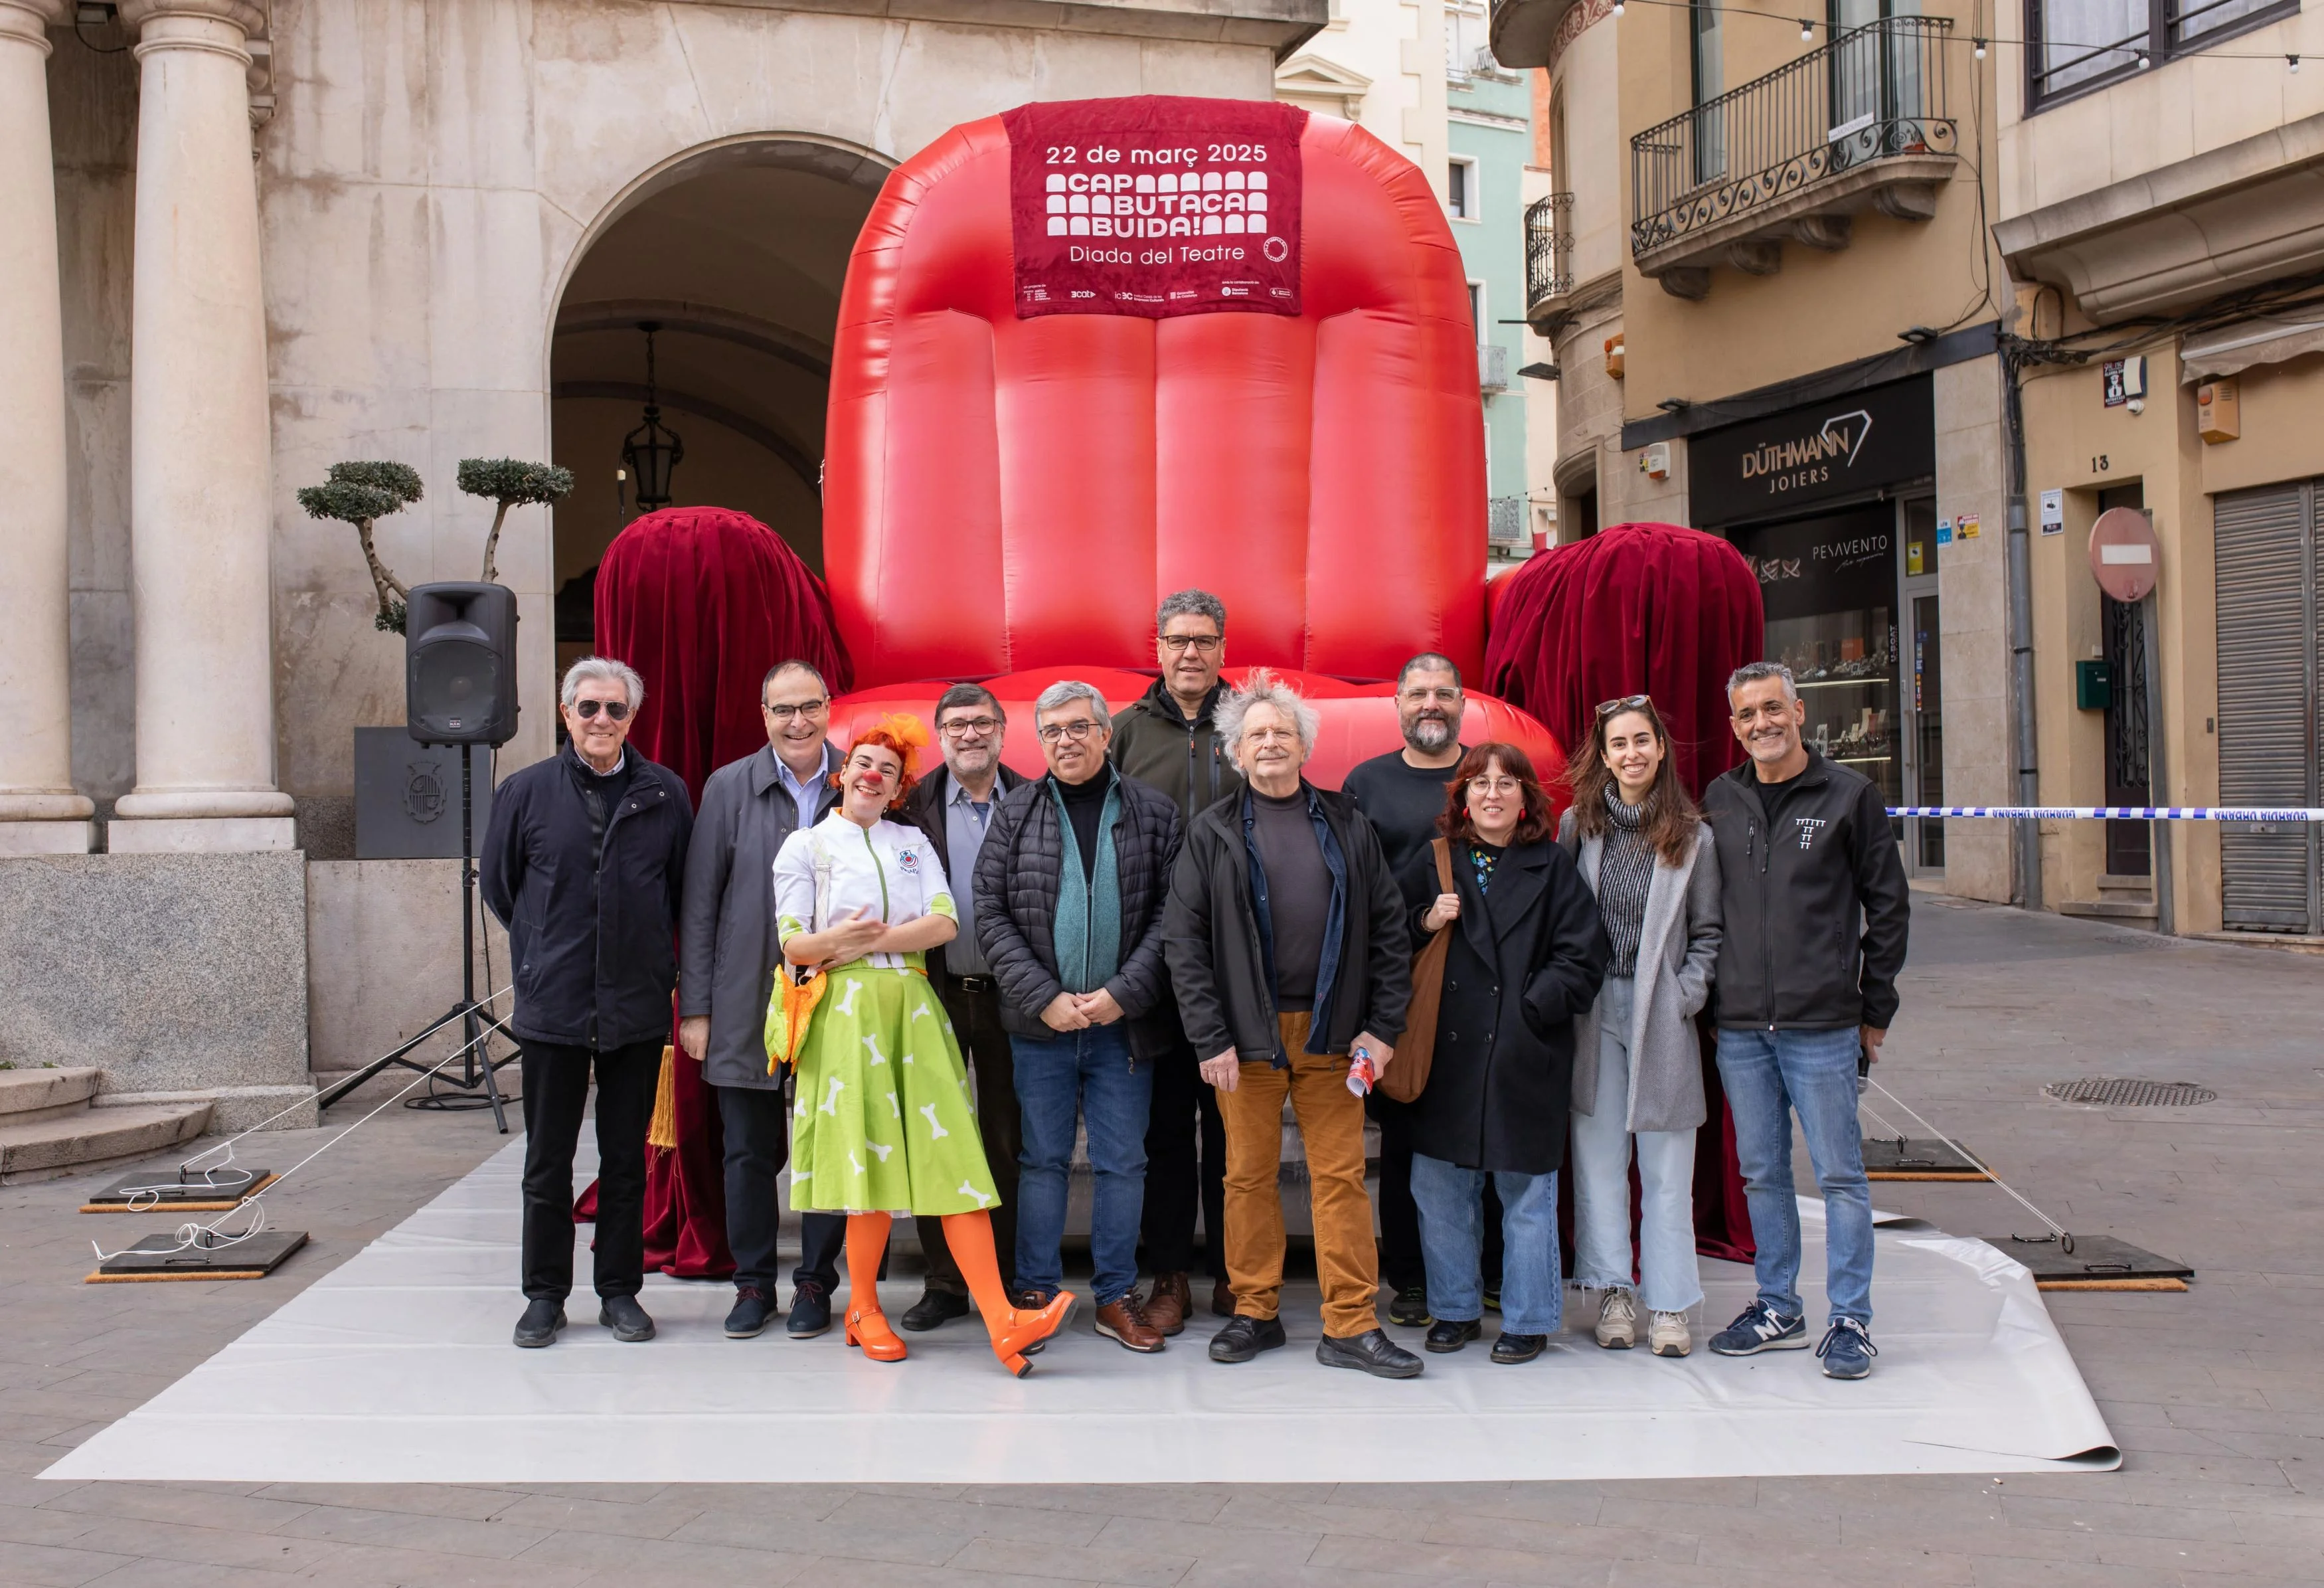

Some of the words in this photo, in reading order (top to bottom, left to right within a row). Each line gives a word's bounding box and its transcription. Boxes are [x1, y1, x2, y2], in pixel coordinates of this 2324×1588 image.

[1046, 145, 1076, 163] 22
[1086, 145, 1121, 163] de
[1131, 147, 1198, 168] març
[1207, 143, 1268, 162] 2025
[1068, 173, 1133, 193] CAP
[1114, 192, 1246, 216] BUTACA
[1092, 217, 1201, 238] BUIDA!
[1070, 246, 1132, 264] Diada
[1140, 247, 1173, 264] del
[1179, 244, 1245, 263] Teatre
[1742, 427, 1849, 479] DÜTHMANN
[2092, 454, 2109, 473] 13
[1769, 466, 1829, 494] JOIERS
[1812, 535, 1888, 561] PESAVENTO
[2214, 810, 2257, 822] URBANA
[2260, 811, 2309, 822] GUARDIA
